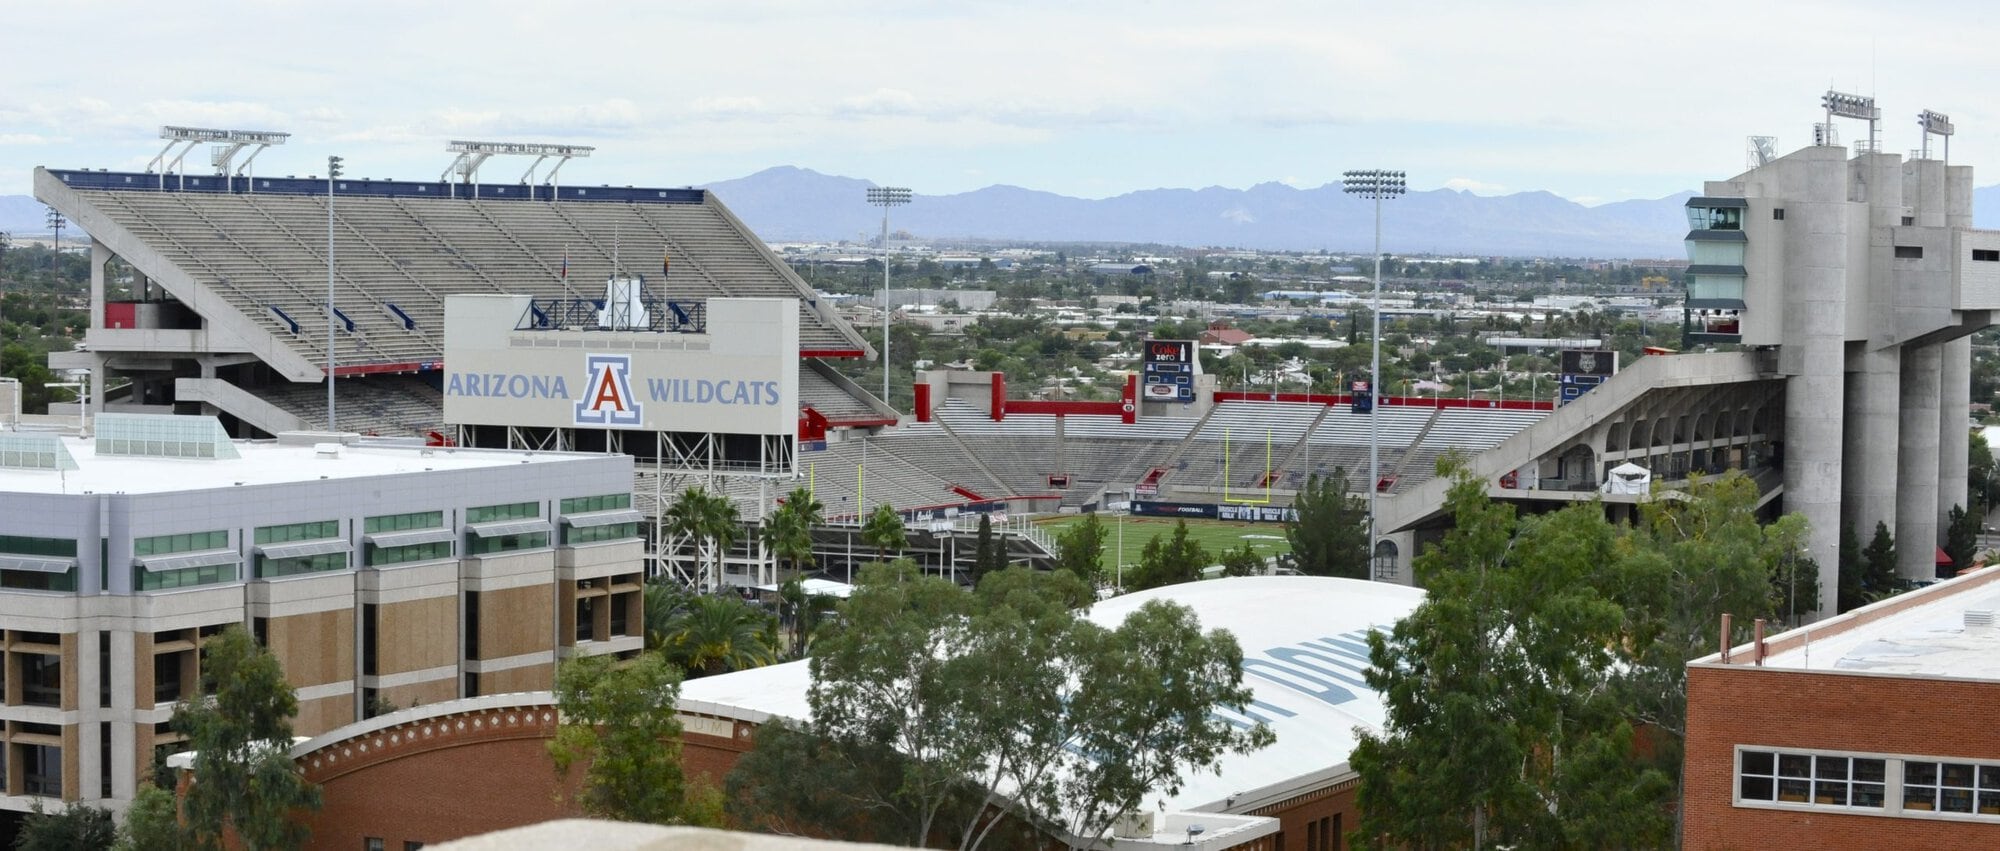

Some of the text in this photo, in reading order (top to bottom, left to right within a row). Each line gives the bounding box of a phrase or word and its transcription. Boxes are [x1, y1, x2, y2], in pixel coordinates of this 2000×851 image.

[1152, 343, 1179, 355] Coke
[447, 355, 780, 426] ARIZONA A WILDCATS
